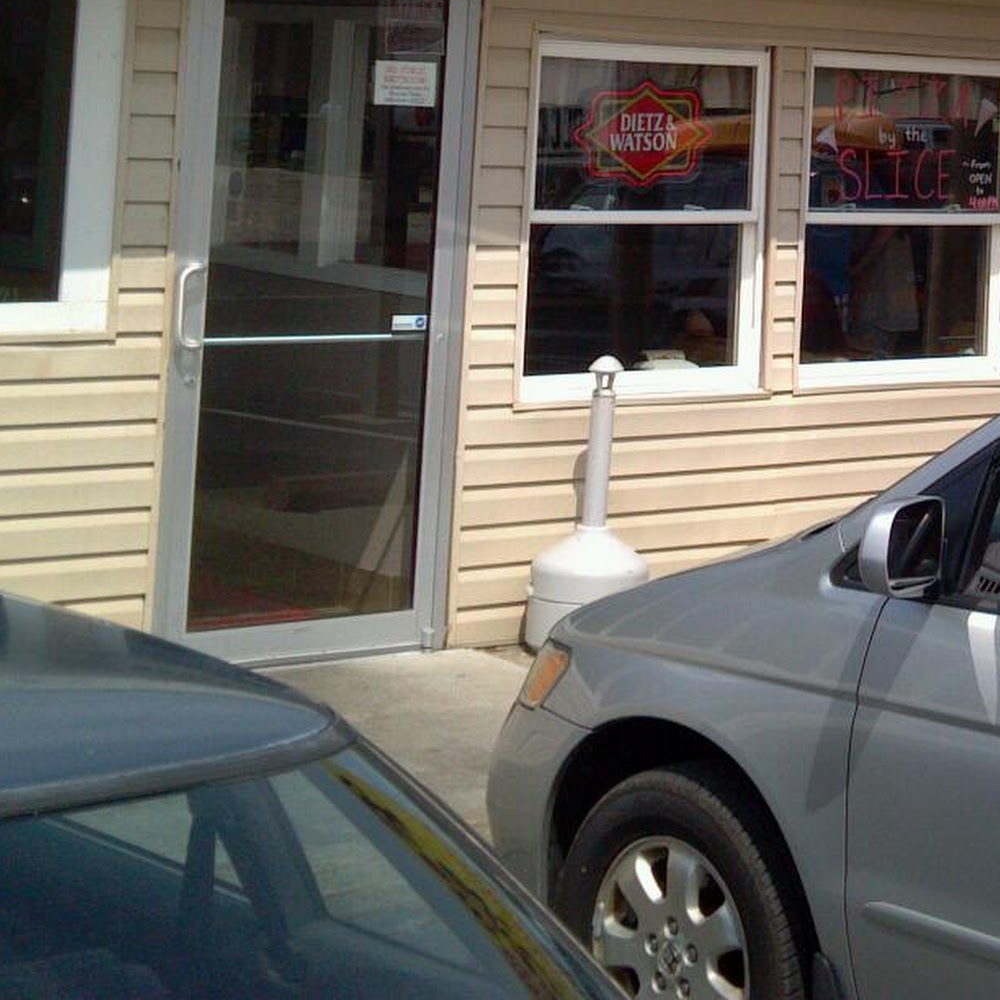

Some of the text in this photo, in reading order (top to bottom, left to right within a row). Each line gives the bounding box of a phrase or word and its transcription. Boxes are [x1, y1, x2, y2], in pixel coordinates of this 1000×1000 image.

[621, 113, 677, 132] DIETZ &
[610, 132, 678, 152] WATSON
[878, 126, 928, 148] by the
[837, 149, 956, 200] SLICE
